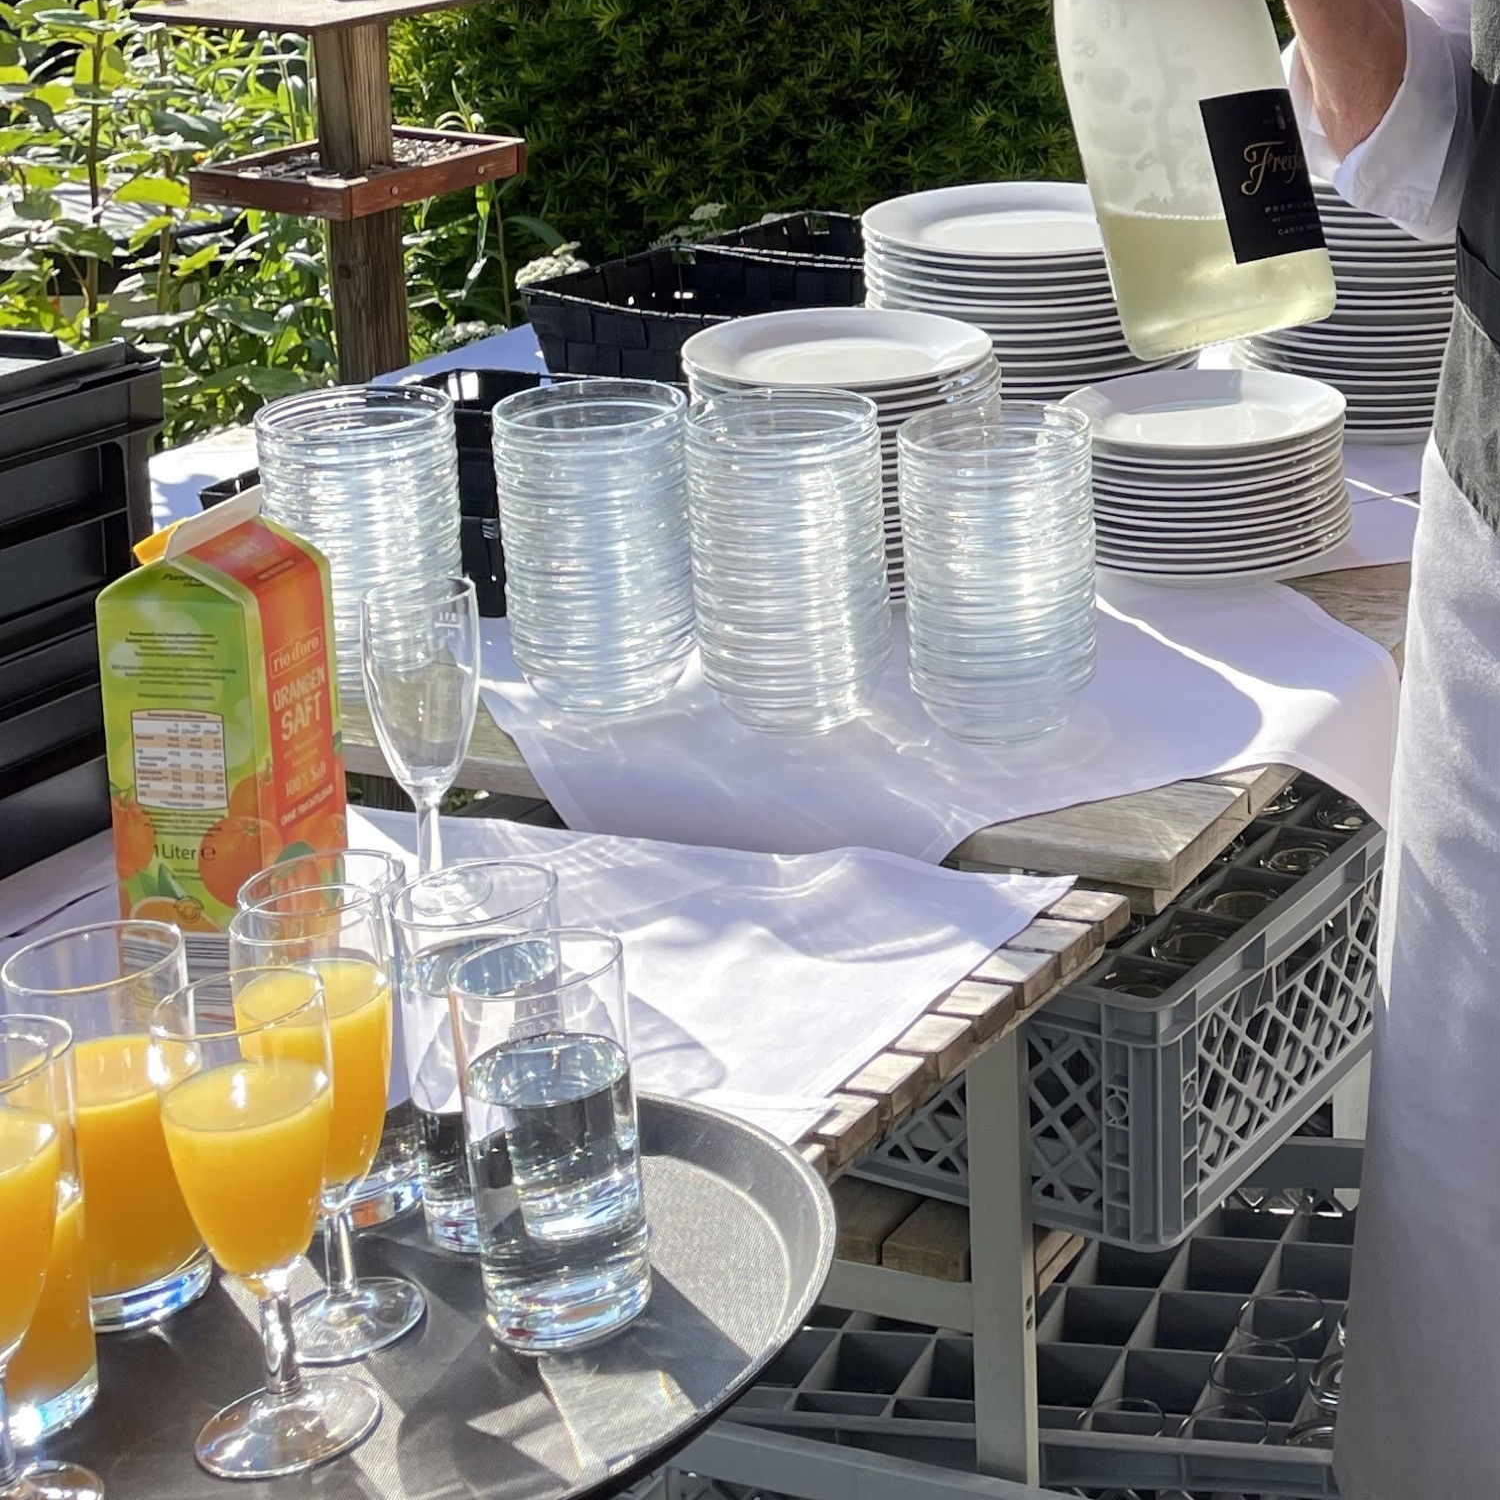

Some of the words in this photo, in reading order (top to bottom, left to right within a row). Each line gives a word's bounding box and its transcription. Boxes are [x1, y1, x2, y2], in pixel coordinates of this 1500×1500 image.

[273, 653, 291, 674] rio
[272, 664, 326, 712] ORANGEN
[281, 690, 322, 741] SAFT
[161, 844, 197, 860] Liter
